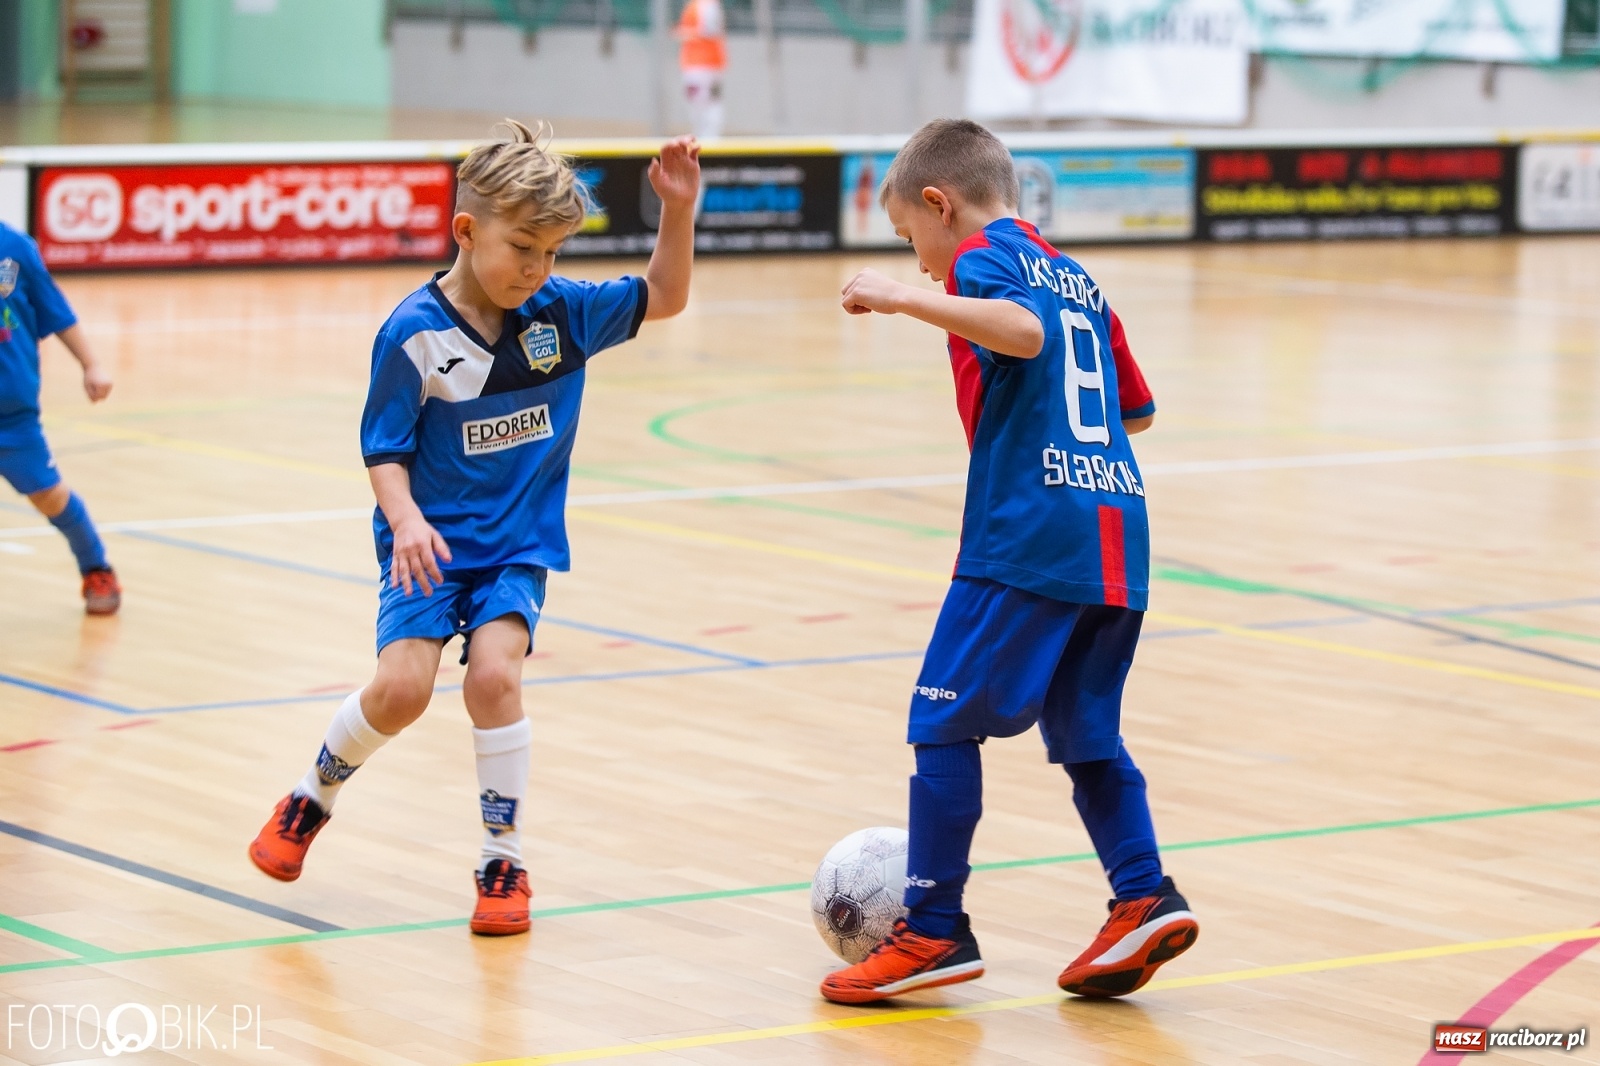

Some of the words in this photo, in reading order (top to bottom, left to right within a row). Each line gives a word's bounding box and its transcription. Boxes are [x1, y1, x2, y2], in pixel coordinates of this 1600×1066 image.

[130, 175, 414, 242] sport-core
[1018, 251, 1060, 294] LKS
[527, 332, 553, 344] AKADEMIA
[535, 346, 554, 358] GOL
[1059, 308, 1110, 446] 8
[467, 408, 547, 445] EDOREM
[469, 440, 508, 451] Edward
